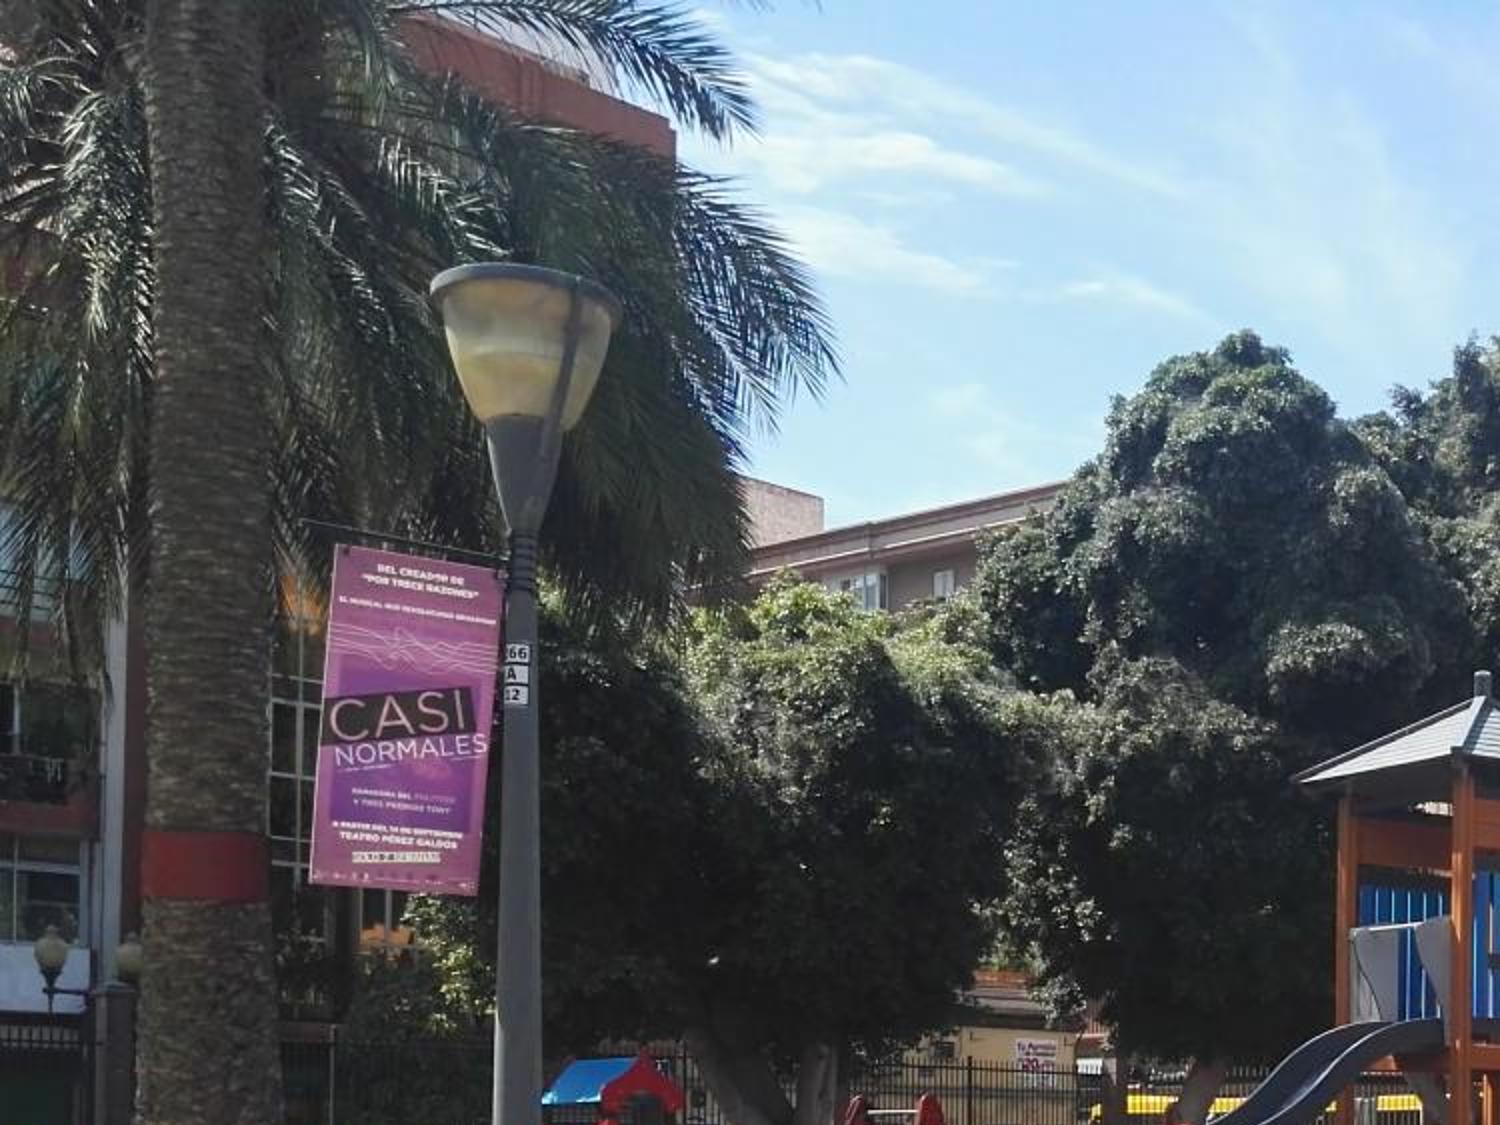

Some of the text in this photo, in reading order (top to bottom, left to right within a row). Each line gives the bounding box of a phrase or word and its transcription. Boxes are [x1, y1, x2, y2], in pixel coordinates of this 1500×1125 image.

[507, 667, 517, 681] A
[329, 688, 465, 741] CASI
[335, 733, 488, 767] NORMALES
[339, 831, 381, 843] TEATRO
